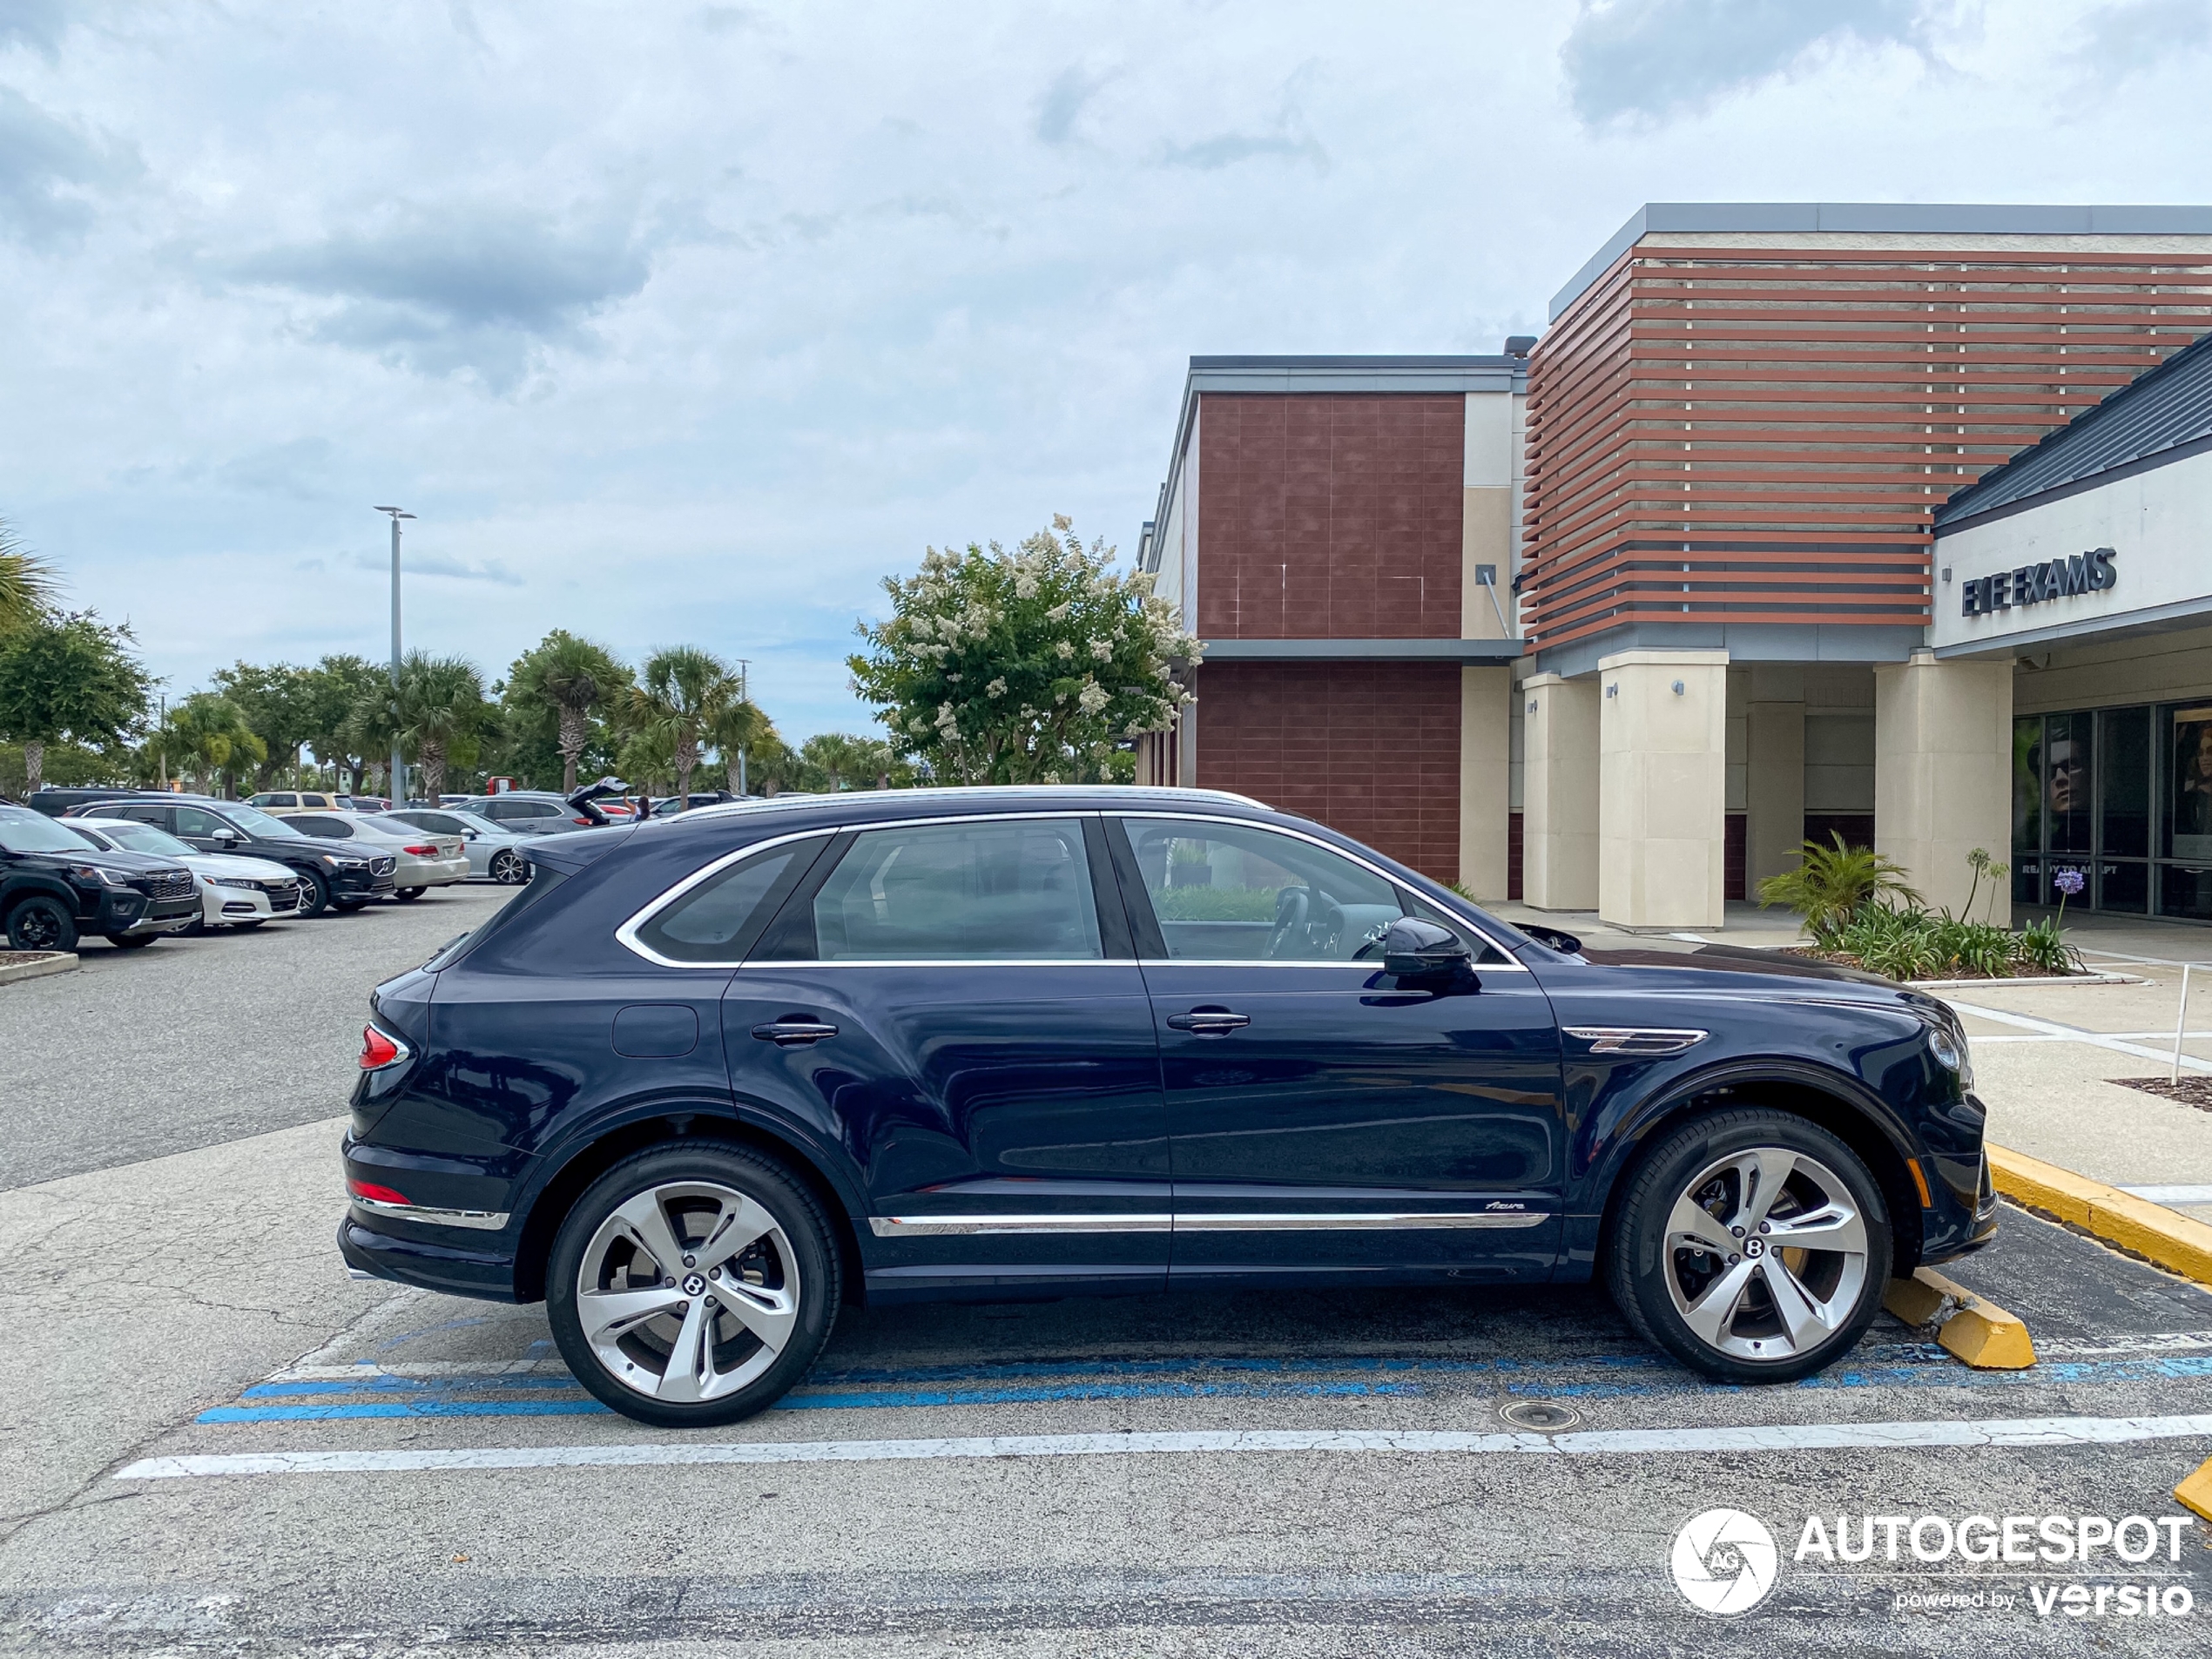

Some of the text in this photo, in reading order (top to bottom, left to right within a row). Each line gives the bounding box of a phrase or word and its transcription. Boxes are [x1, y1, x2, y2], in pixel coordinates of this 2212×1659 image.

[1962, 547, 2117, 617] EYE EXAMS
[1746, 1239, 1762, 1257] B
[684, 1276, 703, 1295] B
